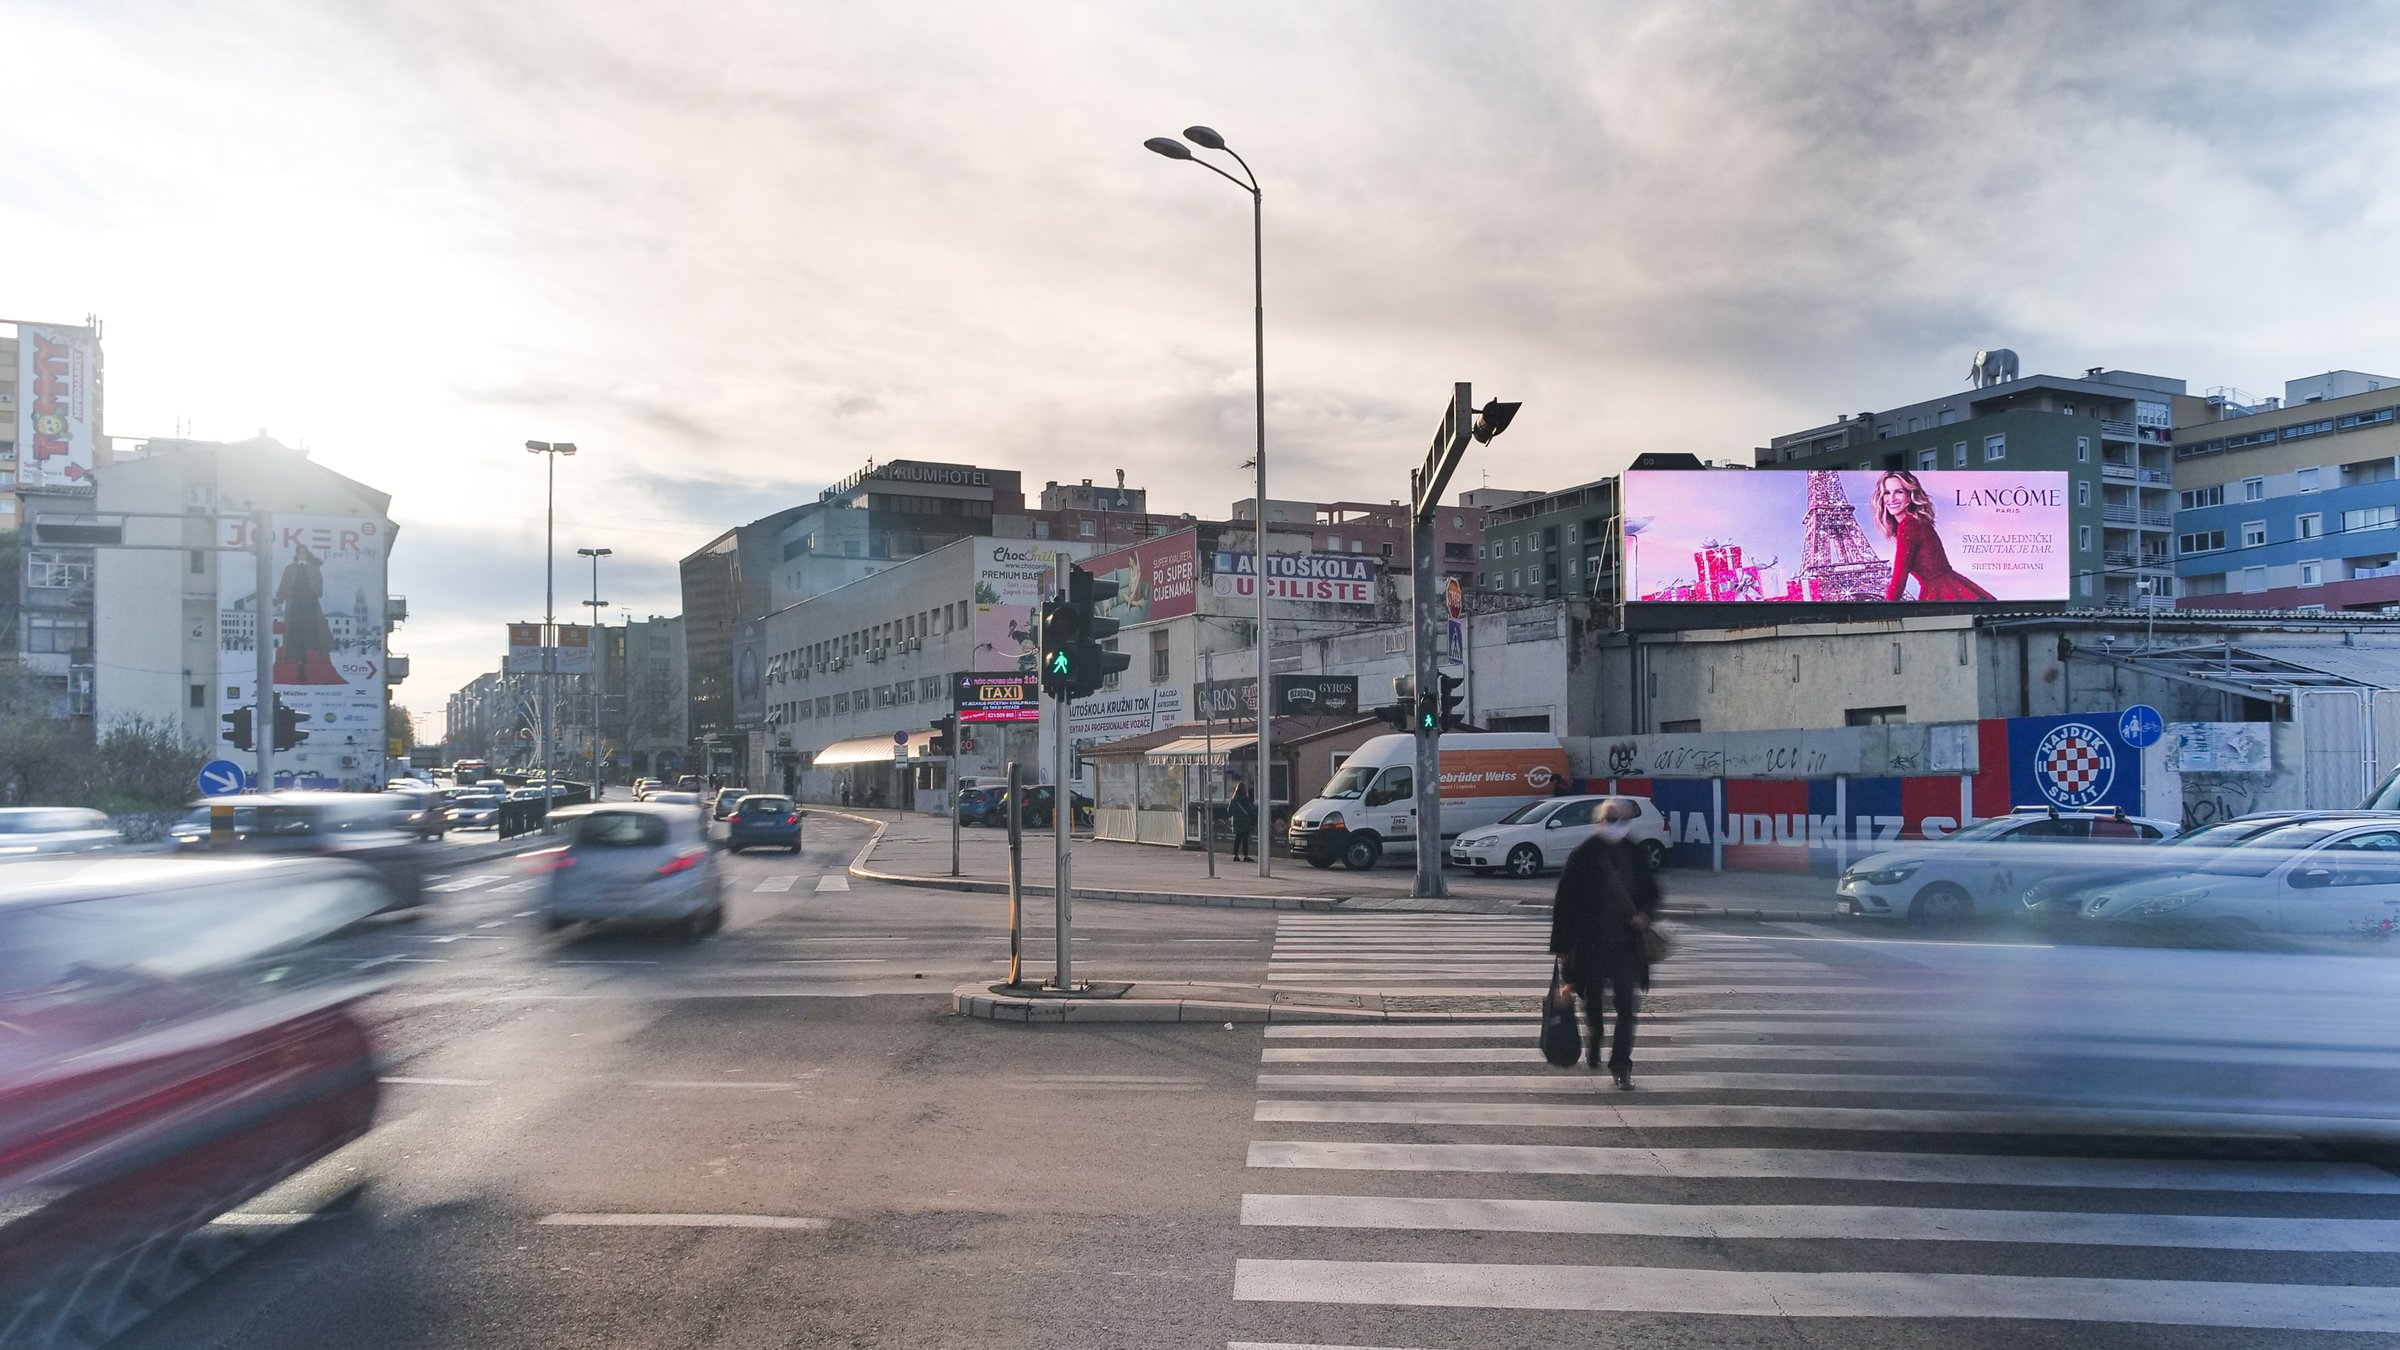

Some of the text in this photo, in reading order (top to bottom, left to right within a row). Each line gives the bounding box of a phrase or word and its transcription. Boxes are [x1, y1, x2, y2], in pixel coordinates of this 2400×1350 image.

[1955, 486, 2061, 507] LANCÔME
[1962, 532, 2053, 544] SVAKI ZAJEDNIČKI
[1962, 544, 2054, 554] TRENUTAK JE DAR.
[1153, 558, 1168, 569] SUPER
[1971, 562, 2044, 571] SRETNI BLAGDANI
[982, 570, 1020, 580] PREMIUM
[1153, 562, 1193, 586] PO SUPER
[1153, 579, 1194, 602] CIJENAMA!
[1448, 590, 1460, 607] STOP
[985, 687, 1018, 698] TAXI
[1070, 697, 1151, 717] UTOŠKOLA KRUŽNI TOK
[1084, 724, 1090, 732] ZA
[1091, 719, 1129, 731] PROFESIONALNE
[1130, 716, 1151, 729] VOZAČE
[2041, 727, 2104, 754] HAJDUK
[1439, 771, 1517, 783] ebrüder Weiss
[2048, 785, 2098, 805] SPLIT
